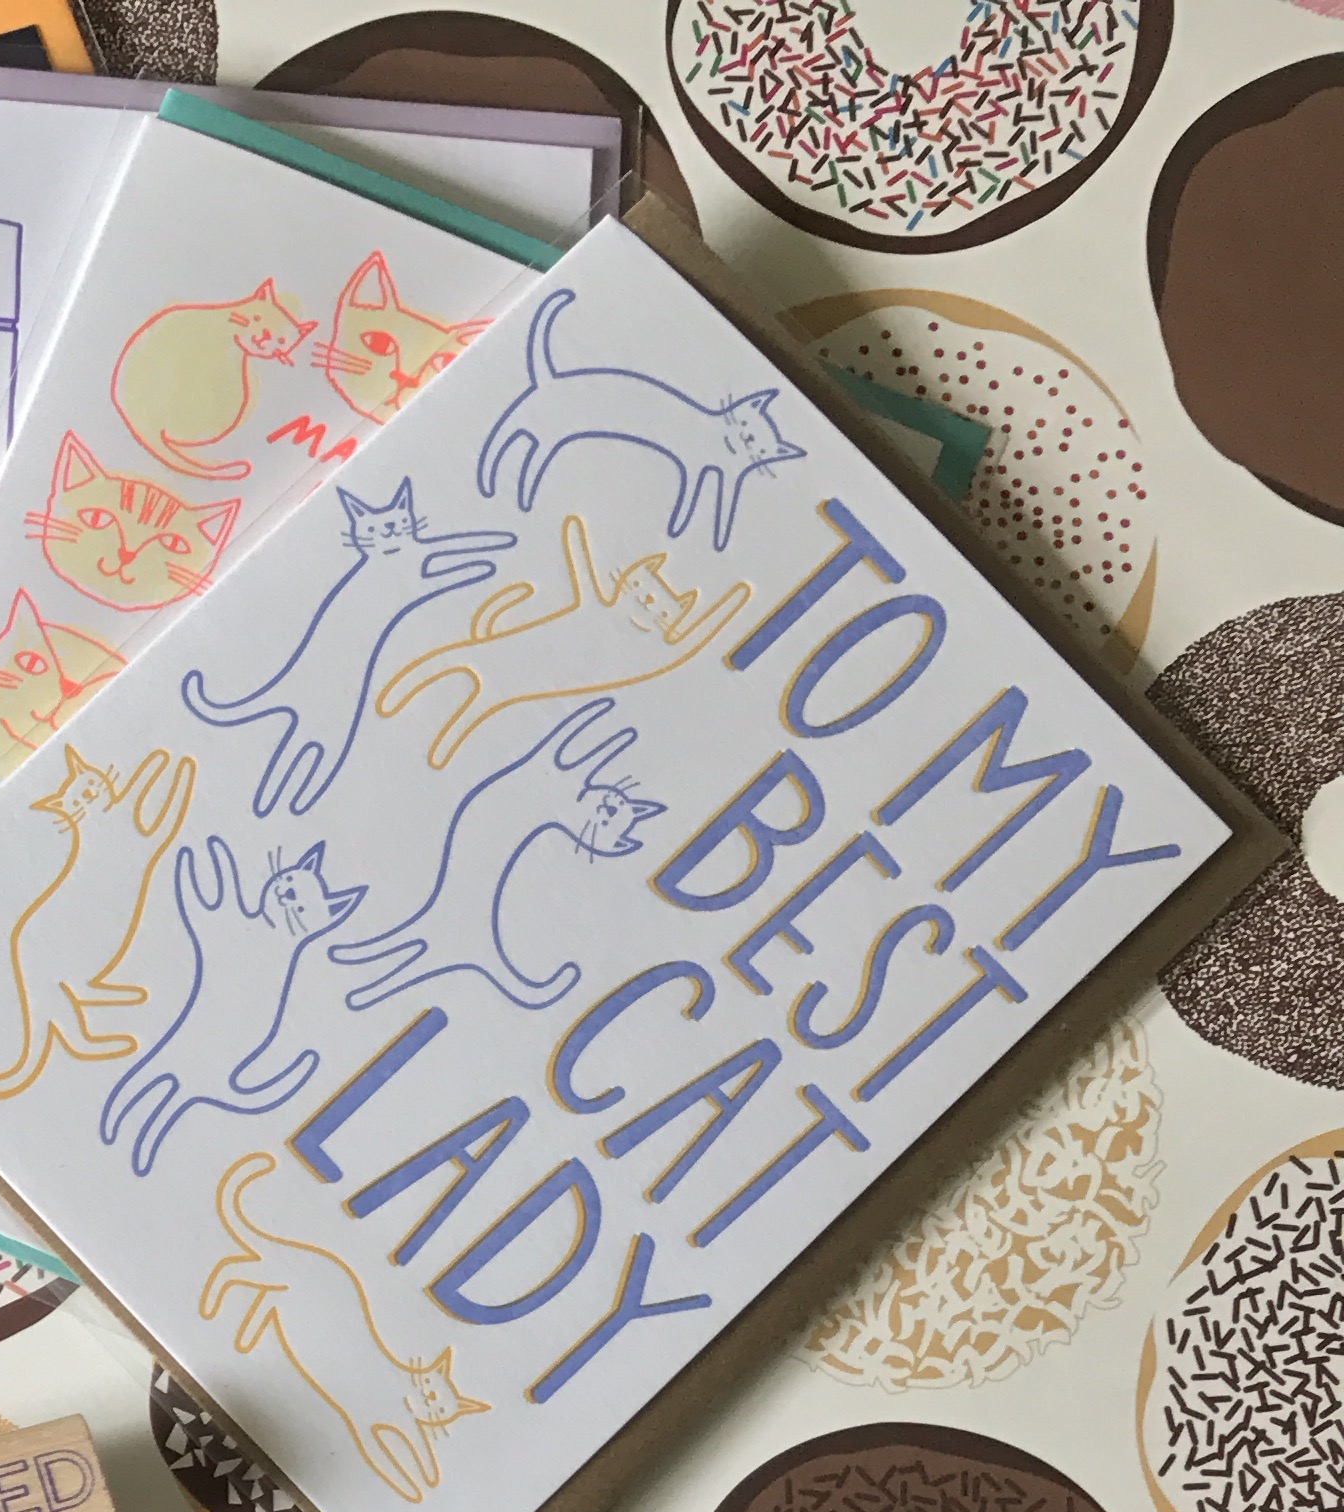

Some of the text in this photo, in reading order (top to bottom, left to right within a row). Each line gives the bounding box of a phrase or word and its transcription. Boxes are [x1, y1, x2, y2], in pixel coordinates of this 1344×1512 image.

[723, 497, 1180, 951] TO MY
[547, 958, 871, 1248] CAT
[649, 750, 1031, 1102] BEST
[285, 1003, 716, 1405] LADY
